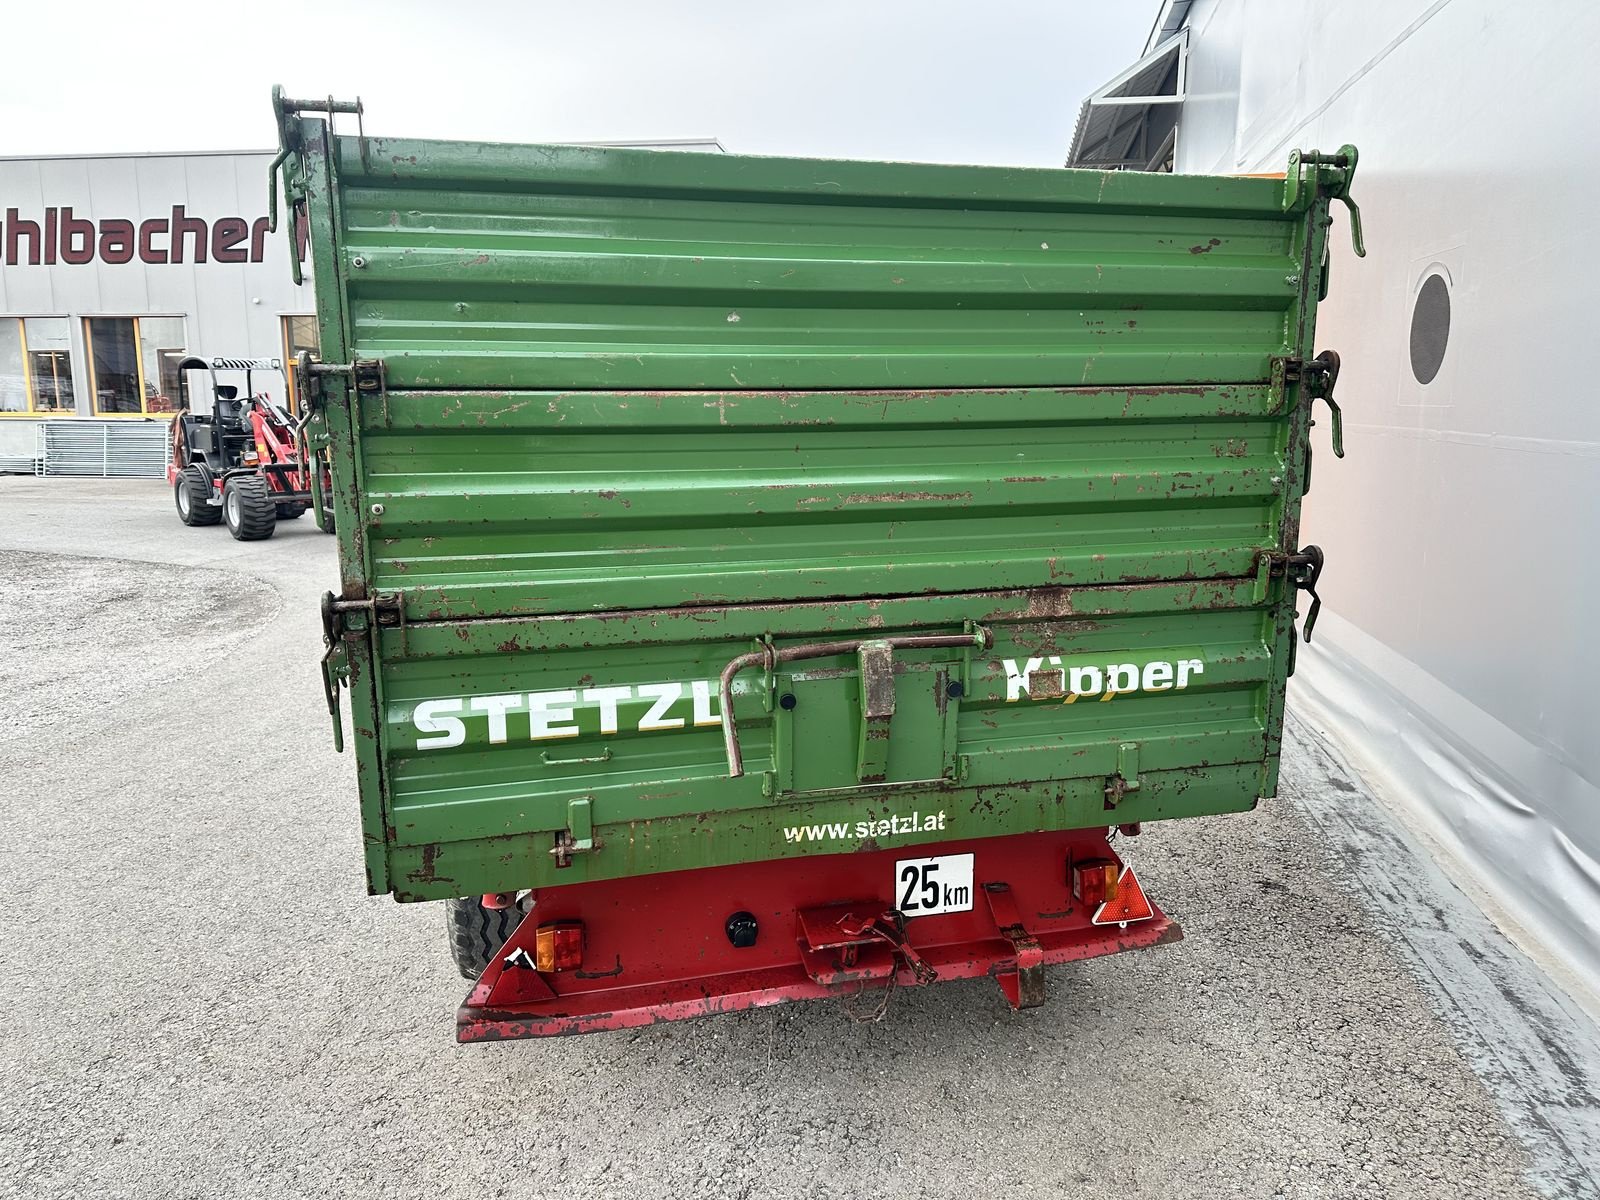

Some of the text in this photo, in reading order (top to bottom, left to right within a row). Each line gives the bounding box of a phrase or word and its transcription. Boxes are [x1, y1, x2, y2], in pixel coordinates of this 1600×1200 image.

[0, 205, 270, 265] hlbacher
[412, 680, 724, 750] STETZL
[783, 810, 946, 843] www.stetzl.at
[900, 864, 969, 911] 25 km
